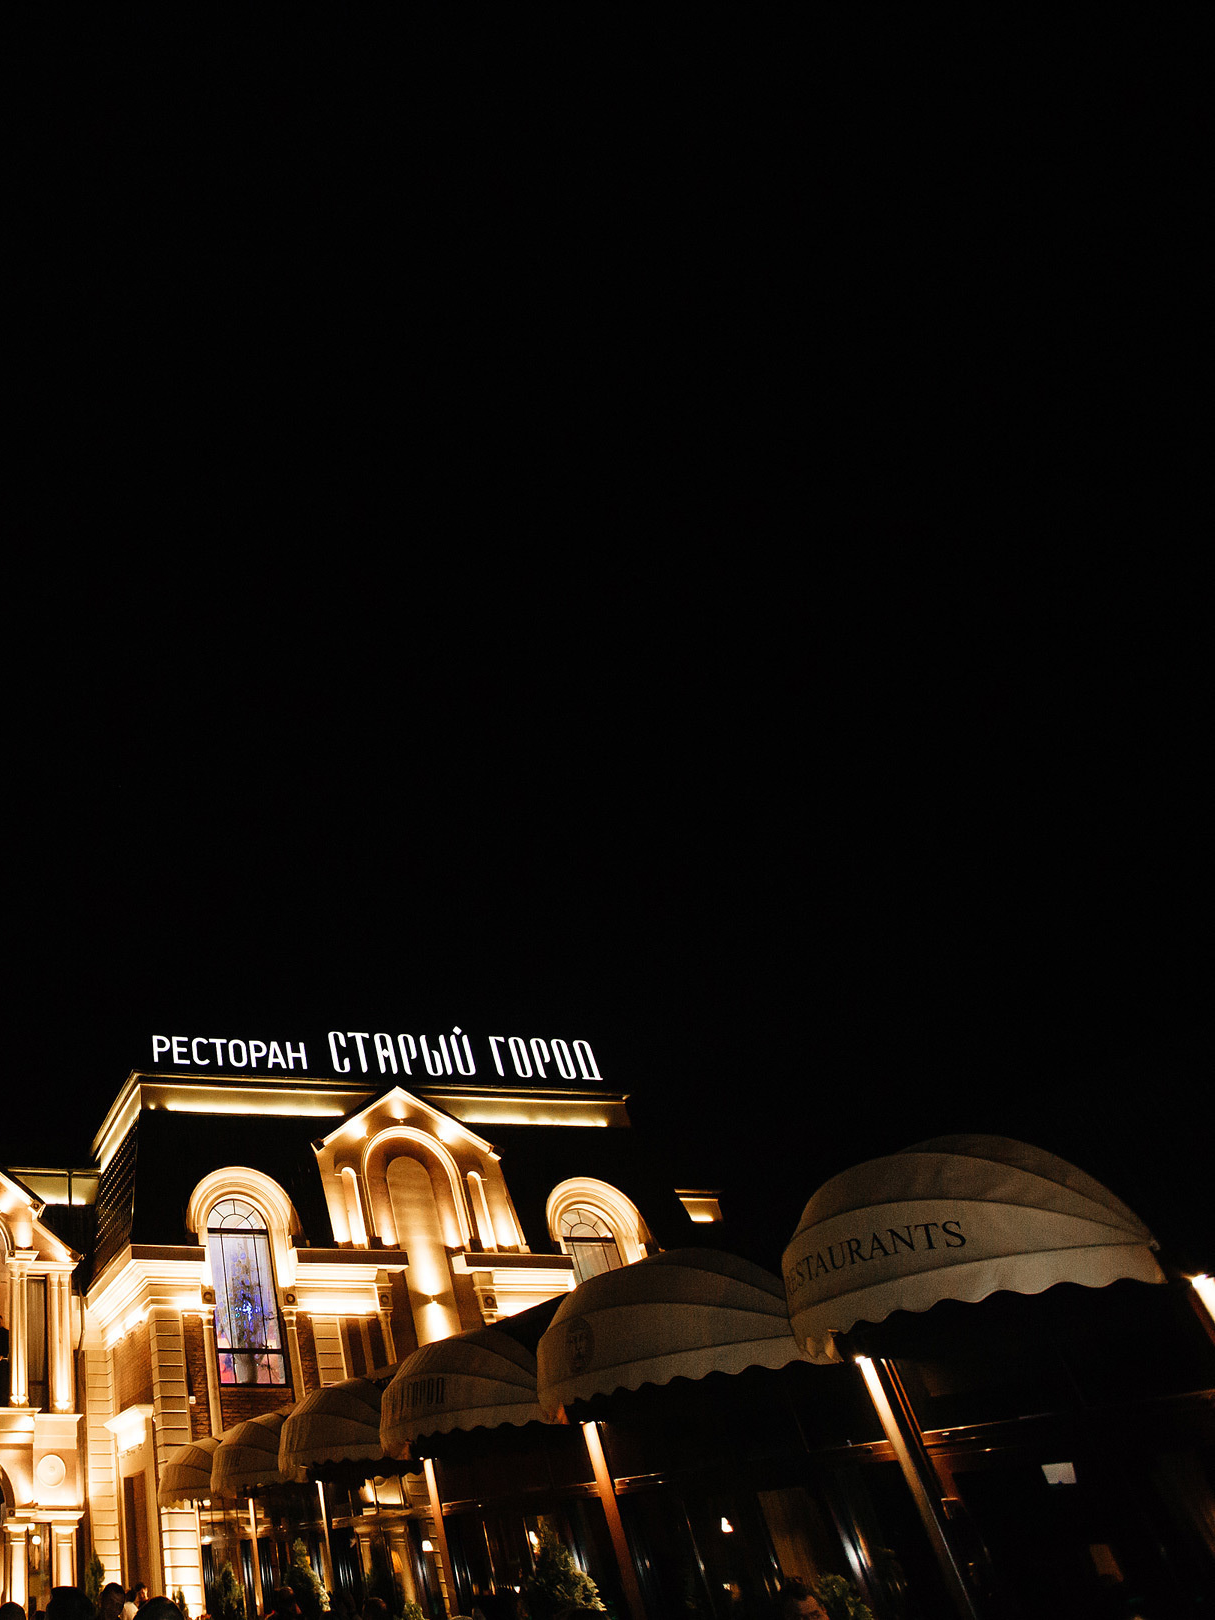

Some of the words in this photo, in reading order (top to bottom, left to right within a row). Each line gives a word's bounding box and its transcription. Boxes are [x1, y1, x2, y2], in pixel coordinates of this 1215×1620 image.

[152, 1034, 308, 1070] РЕСТОРАН
[327, 1026, 477, 1076] СТАРЫЙ
[488, 1035, 604, 1081] ГОРОД
